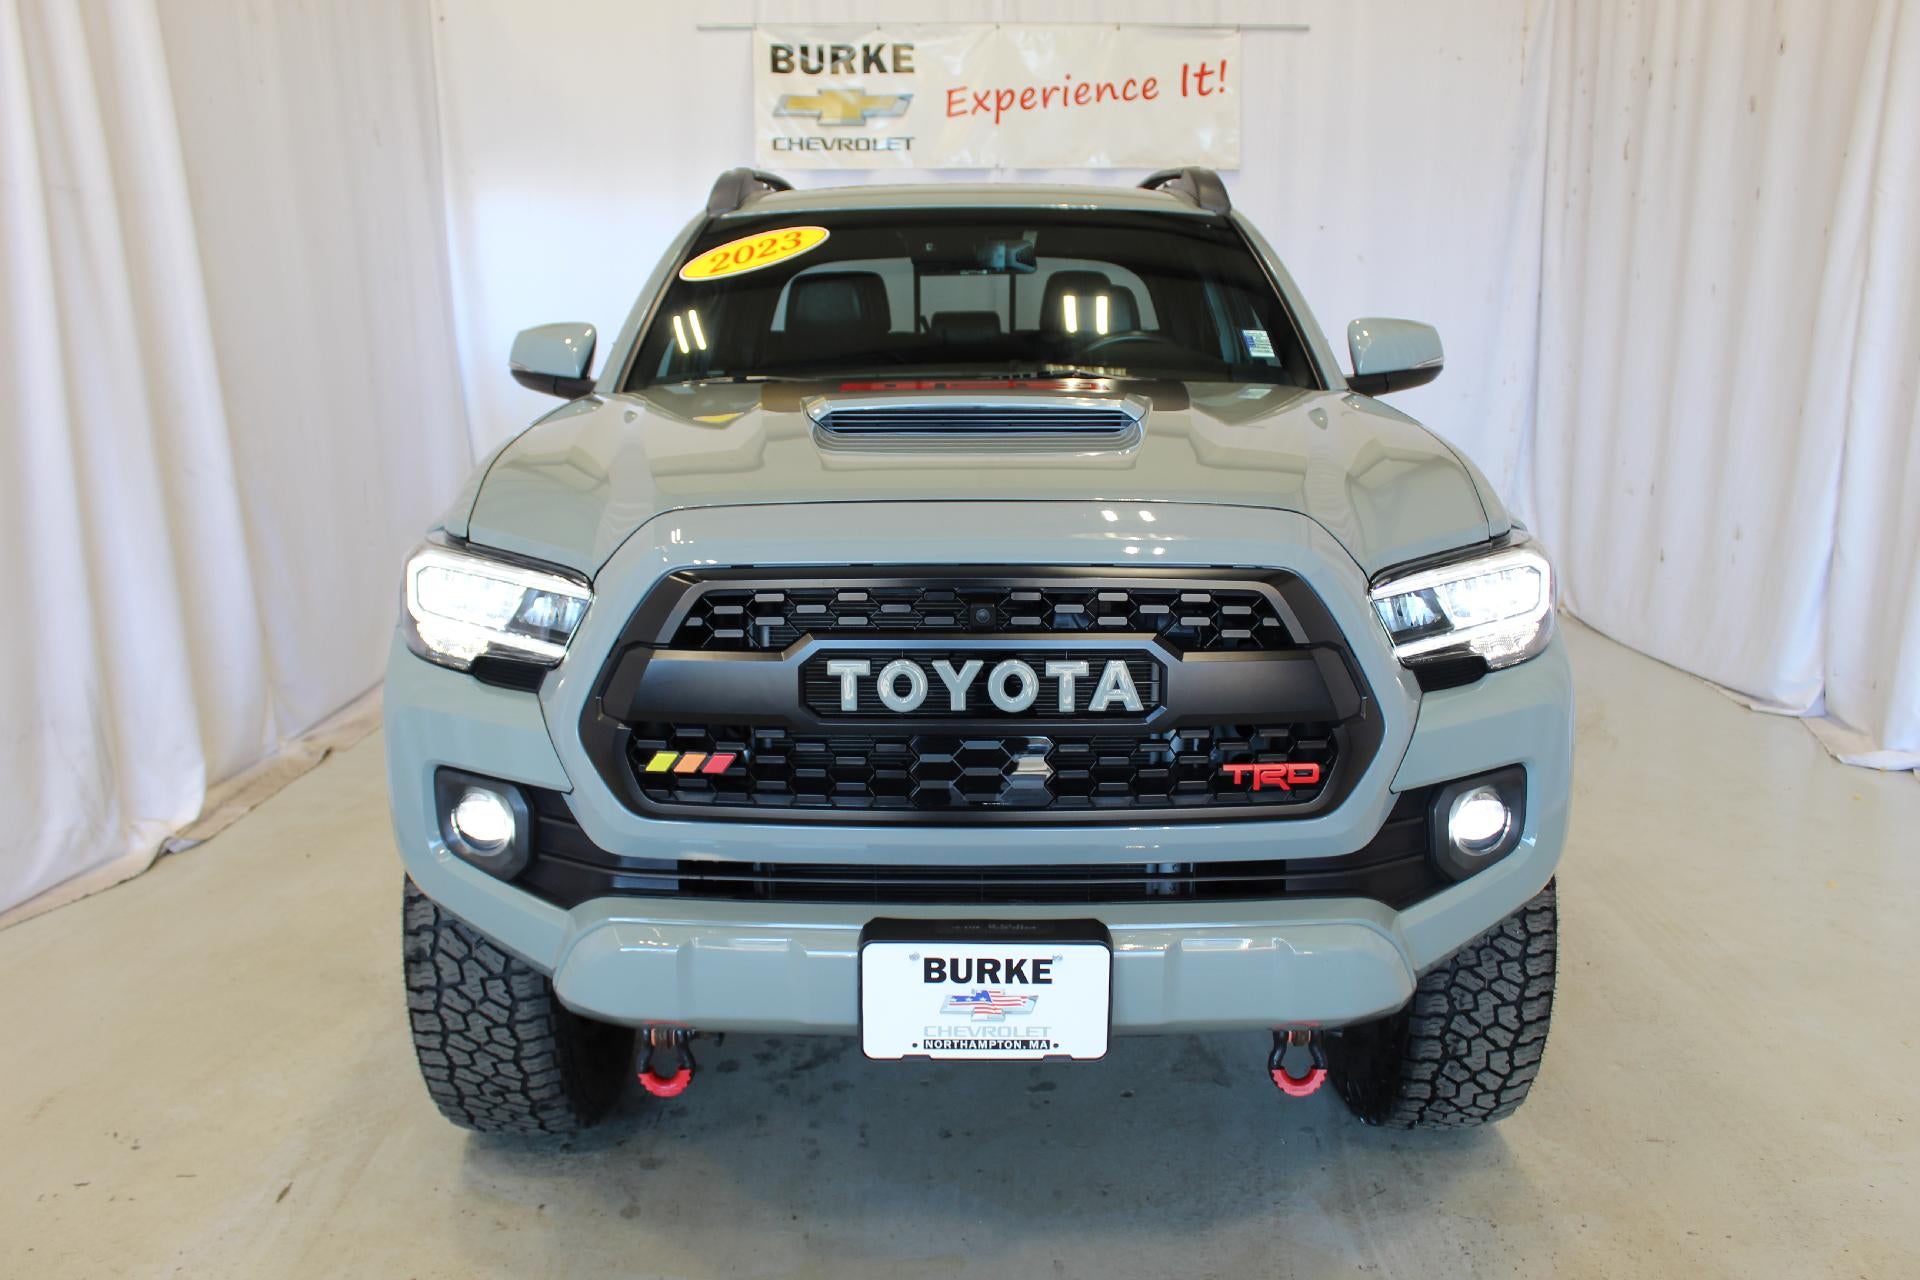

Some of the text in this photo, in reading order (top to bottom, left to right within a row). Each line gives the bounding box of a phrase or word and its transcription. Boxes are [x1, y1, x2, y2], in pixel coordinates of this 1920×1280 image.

[770, 43, 915, 74] BURKE
[946, 59, 1227, 125] Experience It!
[772, 136, 916, 152] CHEVROLET
[710, 231, 802, 274] 2023
[827, 659, 1145, 712] TOYOTA
[1222, 763, 1320, 791] TRD
[924, 957, 1053, 984] BURKE
[924, 1026, 1052, 1038] CHEVROLET
[1029, 1040, 1048, 1049] MA
